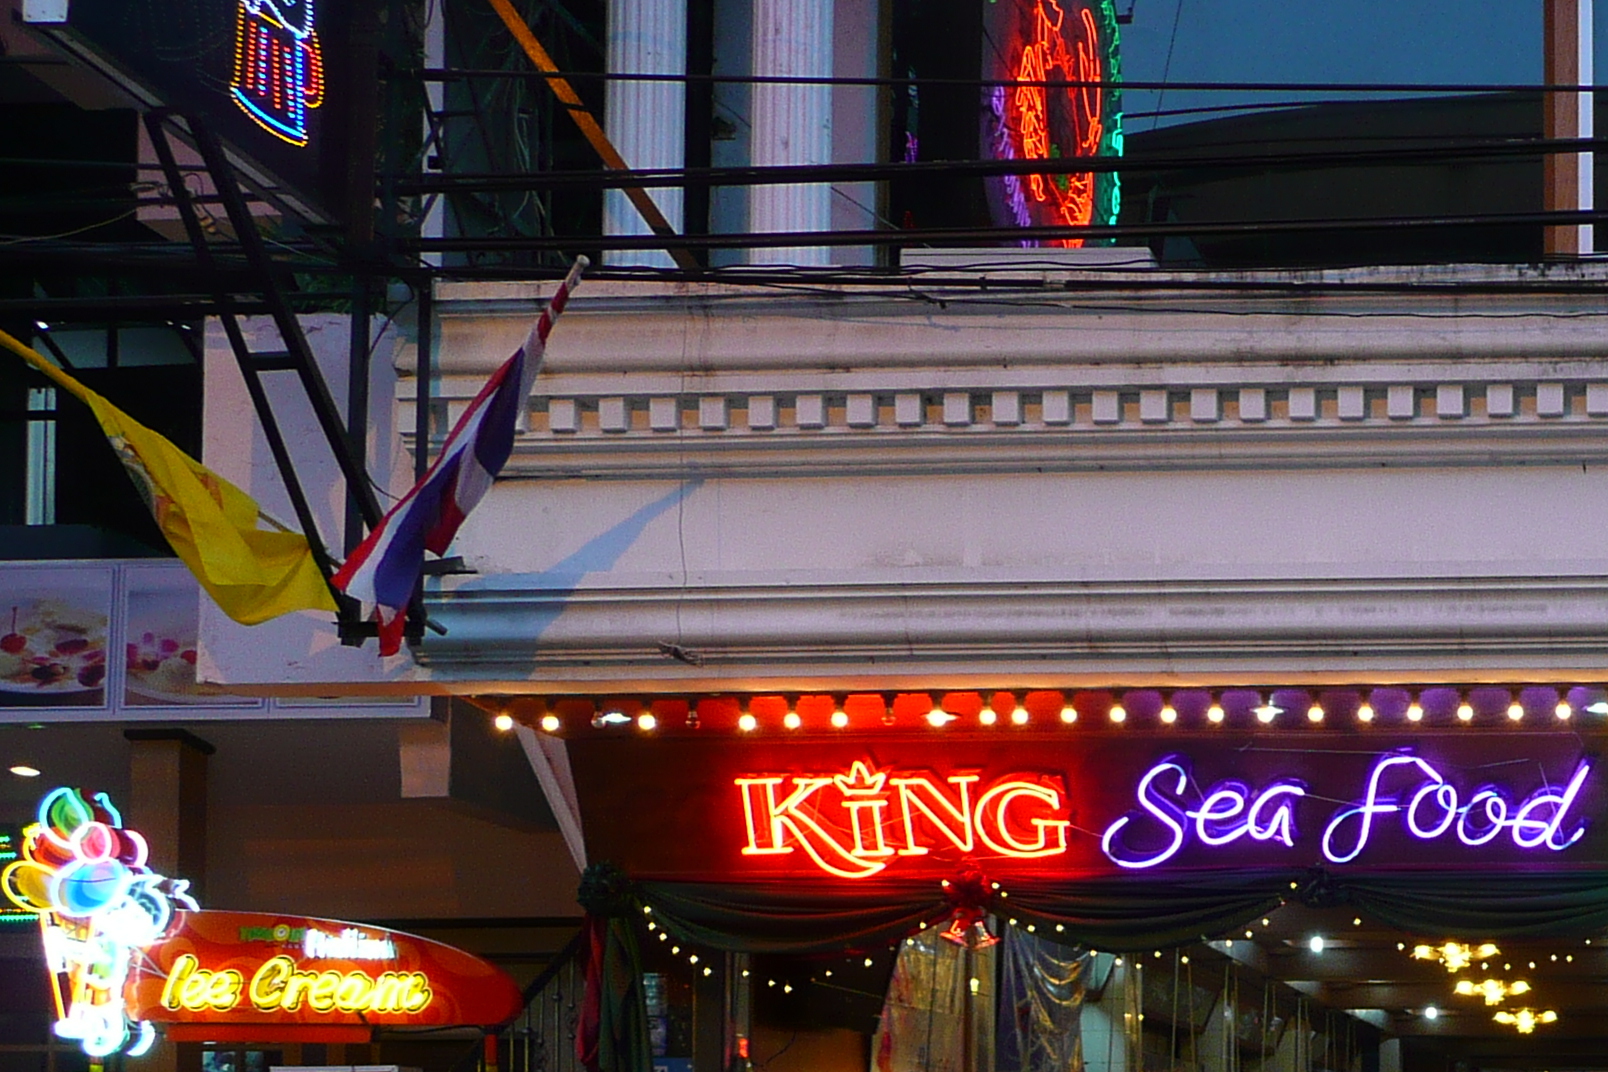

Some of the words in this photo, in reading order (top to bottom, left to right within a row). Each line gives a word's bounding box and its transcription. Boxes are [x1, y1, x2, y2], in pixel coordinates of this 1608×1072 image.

[1100, 757, 1303, 869] Sea
[160, 954, 243, 1011] Ice
[249, 954, 434, 1013] Cream
